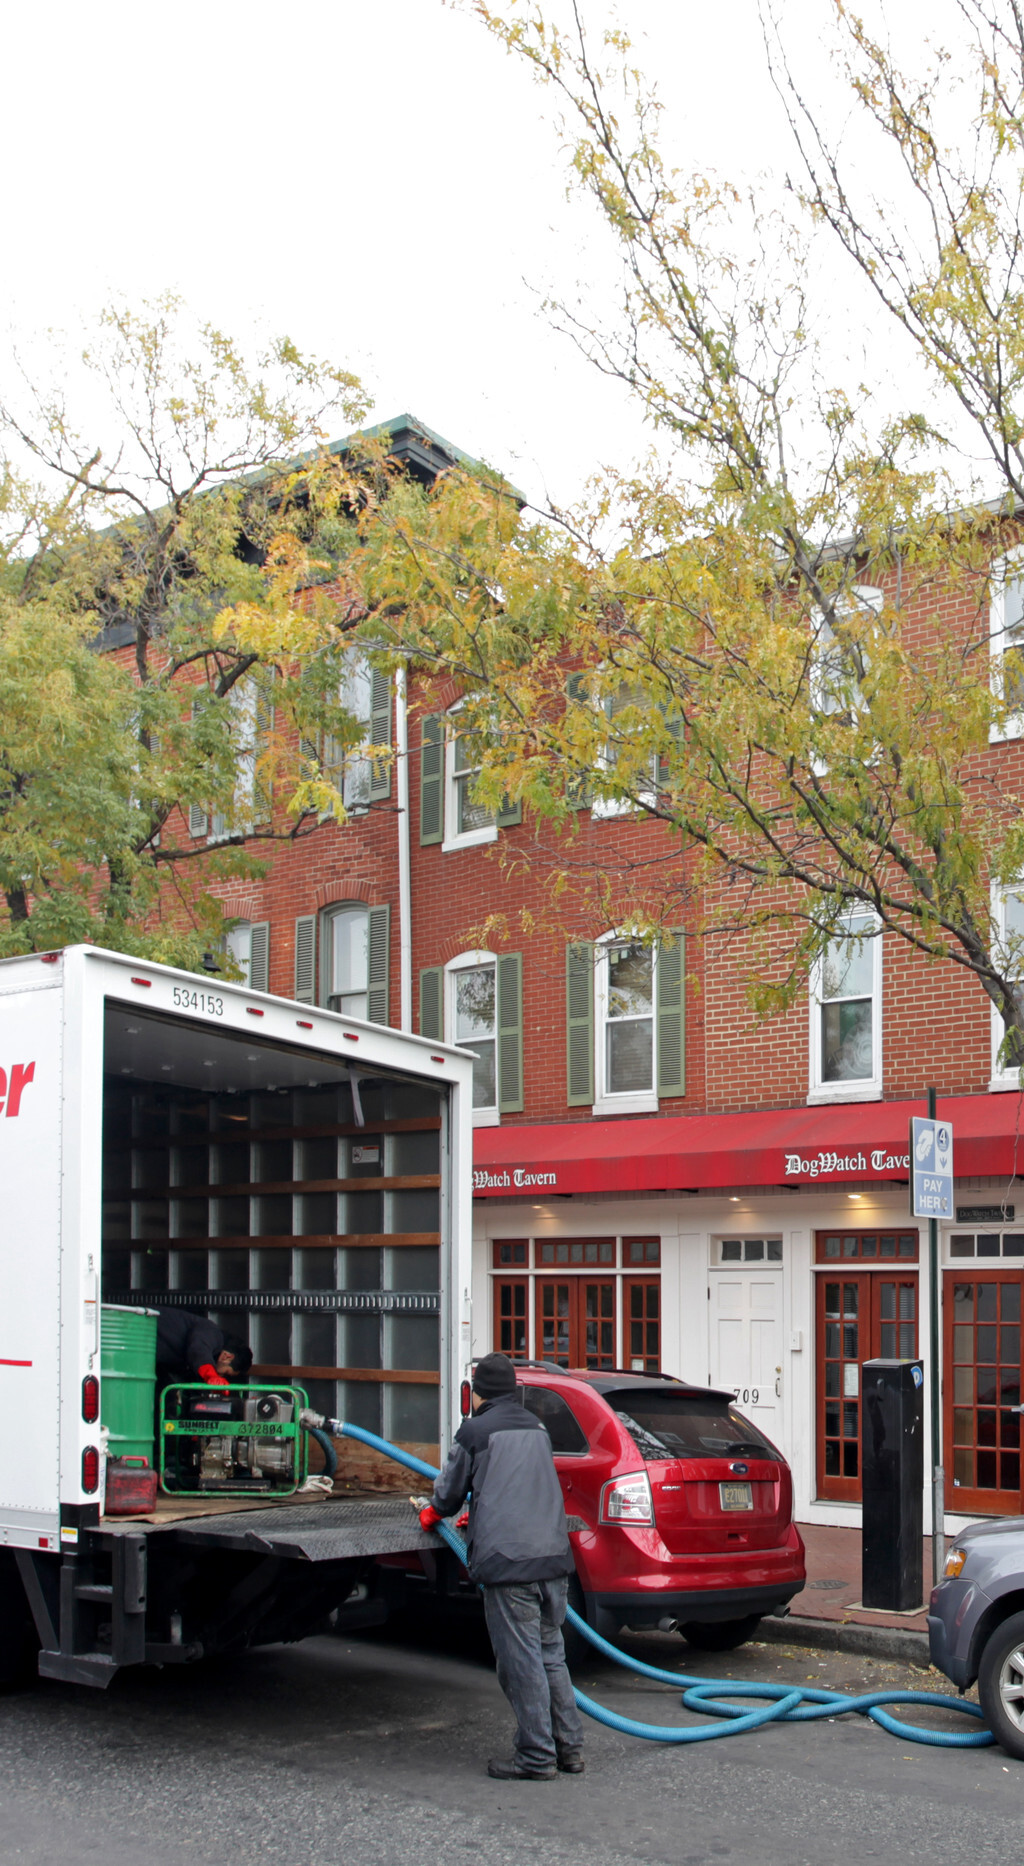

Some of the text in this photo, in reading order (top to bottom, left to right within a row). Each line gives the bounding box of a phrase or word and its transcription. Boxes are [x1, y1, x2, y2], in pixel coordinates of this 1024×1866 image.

[173, 987, 224, 1016] 534153
[0, 1061, 36, 1117] r
[784, 1152, 867, 1177] DogWatch
[471, 1169, 557, 1192] Watch Tavern
[923, 1178, 943, 1193] PAY
[733, 1389, 760, 1404] 709
